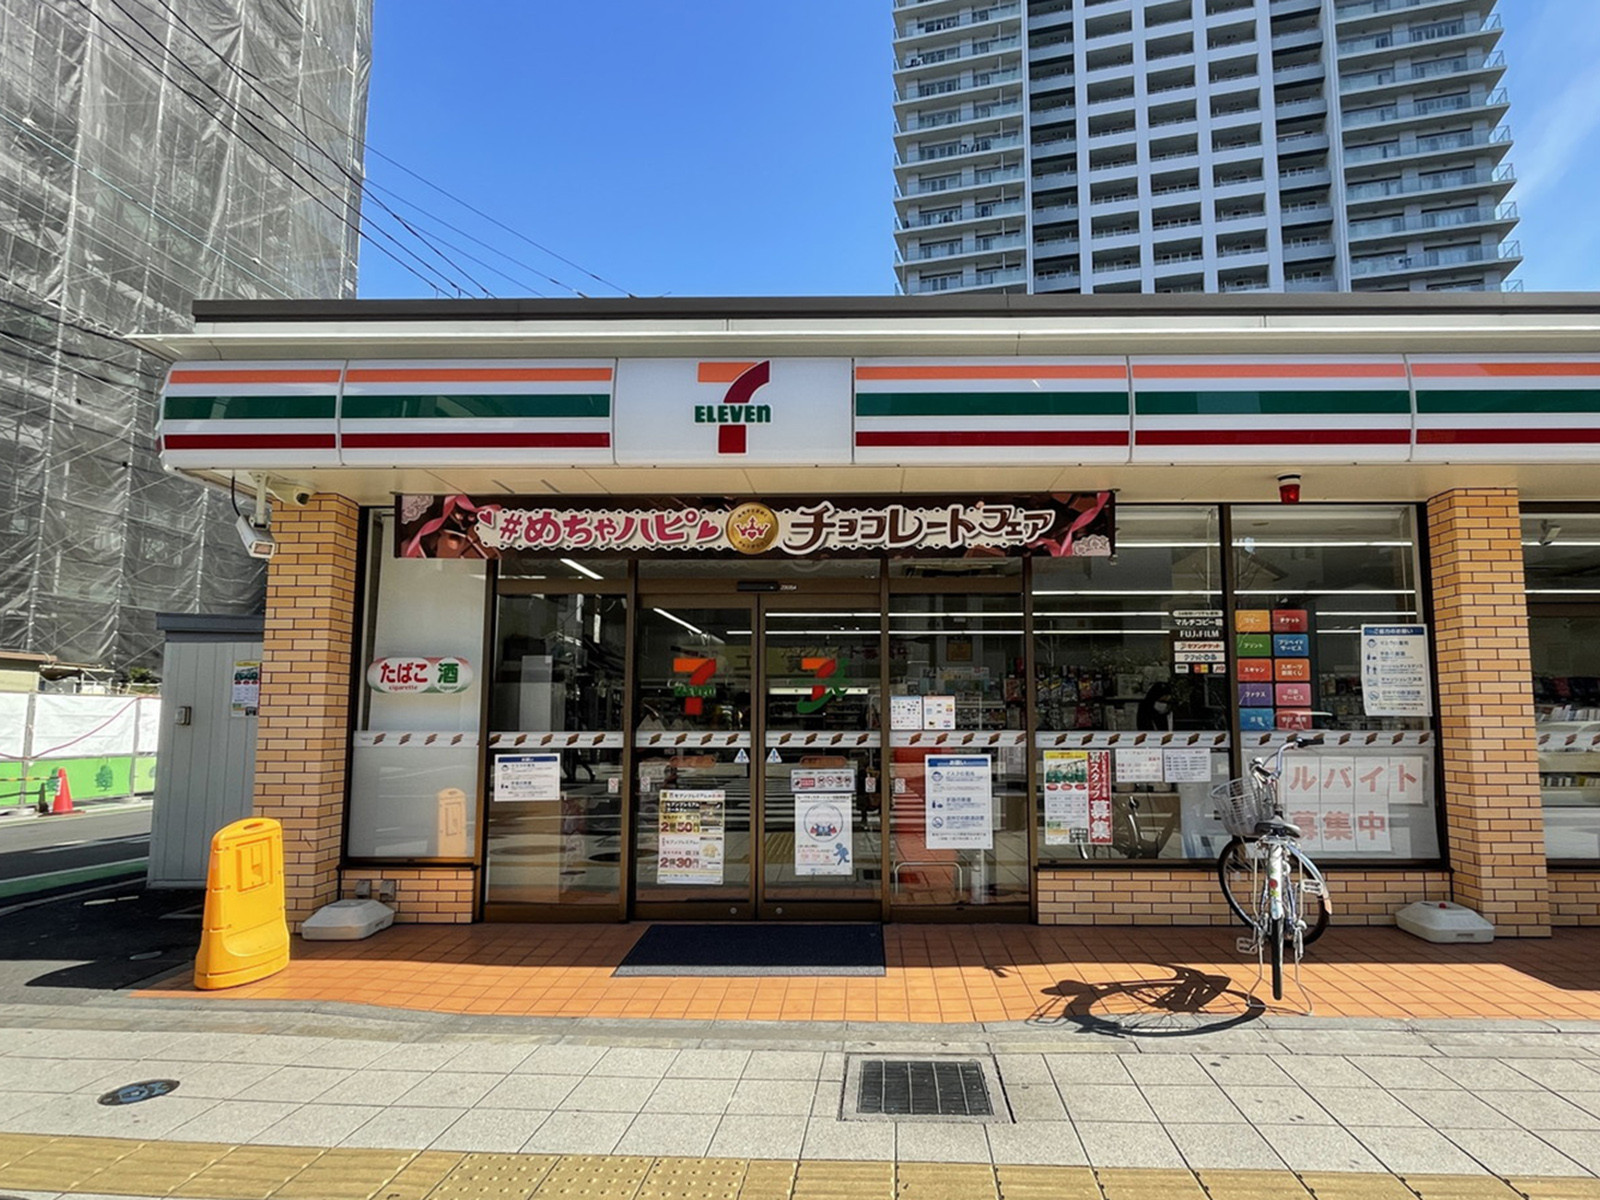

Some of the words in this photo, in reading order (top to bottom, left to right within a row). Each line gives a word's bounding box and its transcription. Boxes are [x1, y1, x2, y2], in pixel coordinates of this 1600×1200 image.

[694, 404, 772, 424] ELEVEn
[499, 509, 699, 546] #めちゃハピ
[784, 502, 1053, 551] チョコレートフェア
[380, 662, 428, 683] たばこ
[437, 662, 459, 684] 酒
[1262, 764, 1417, 792] ルバイト
